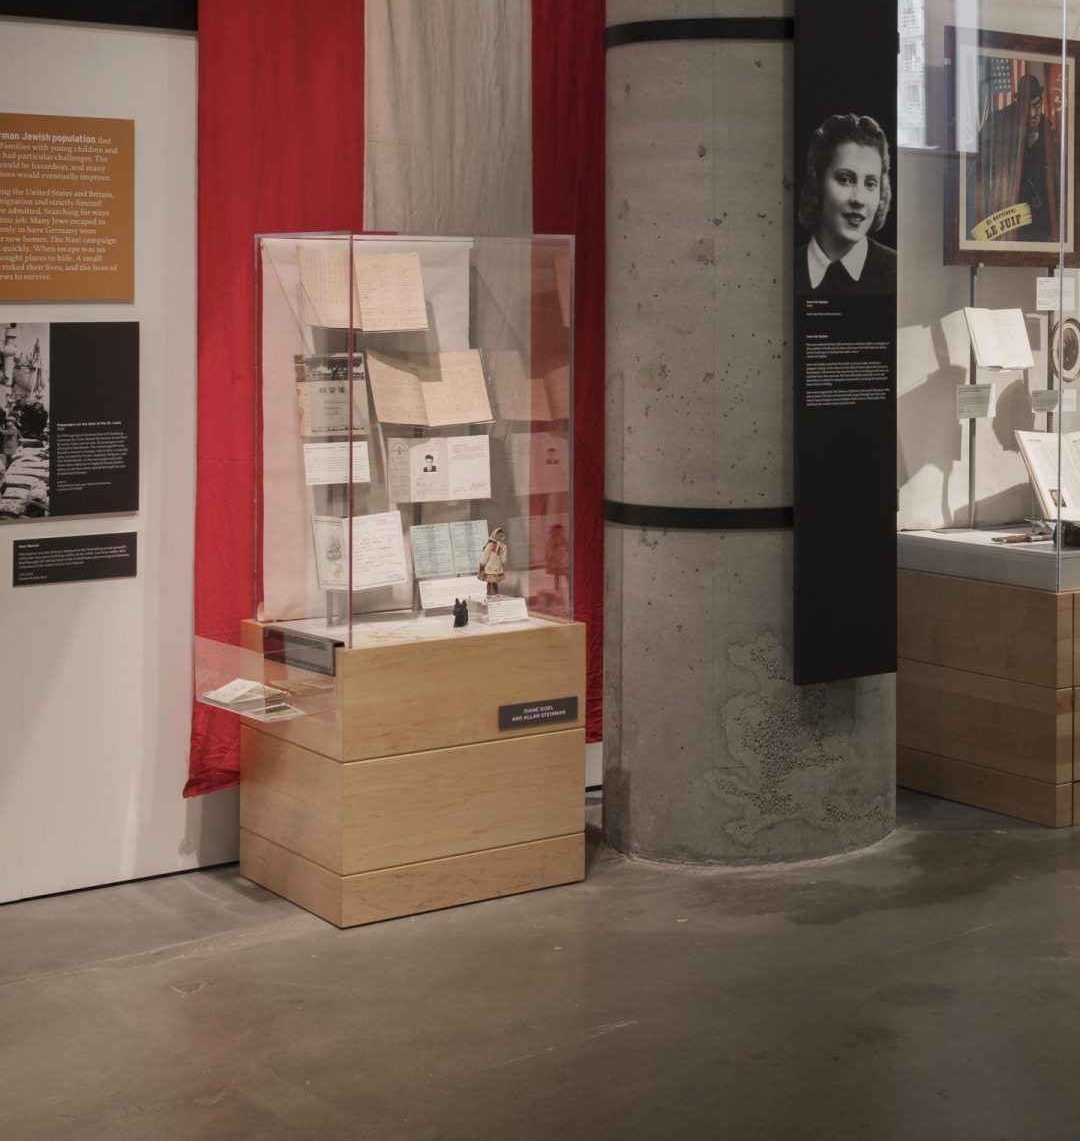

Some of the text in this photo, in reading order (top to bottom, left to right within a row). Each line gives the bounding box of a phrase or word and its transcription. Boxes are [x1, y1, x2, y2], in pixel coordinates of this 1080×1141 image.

[22, 132, 51, 141] Jewish
[52, 134, 96, 144] population
[985, 214, 1021, 239] LE JUIF
